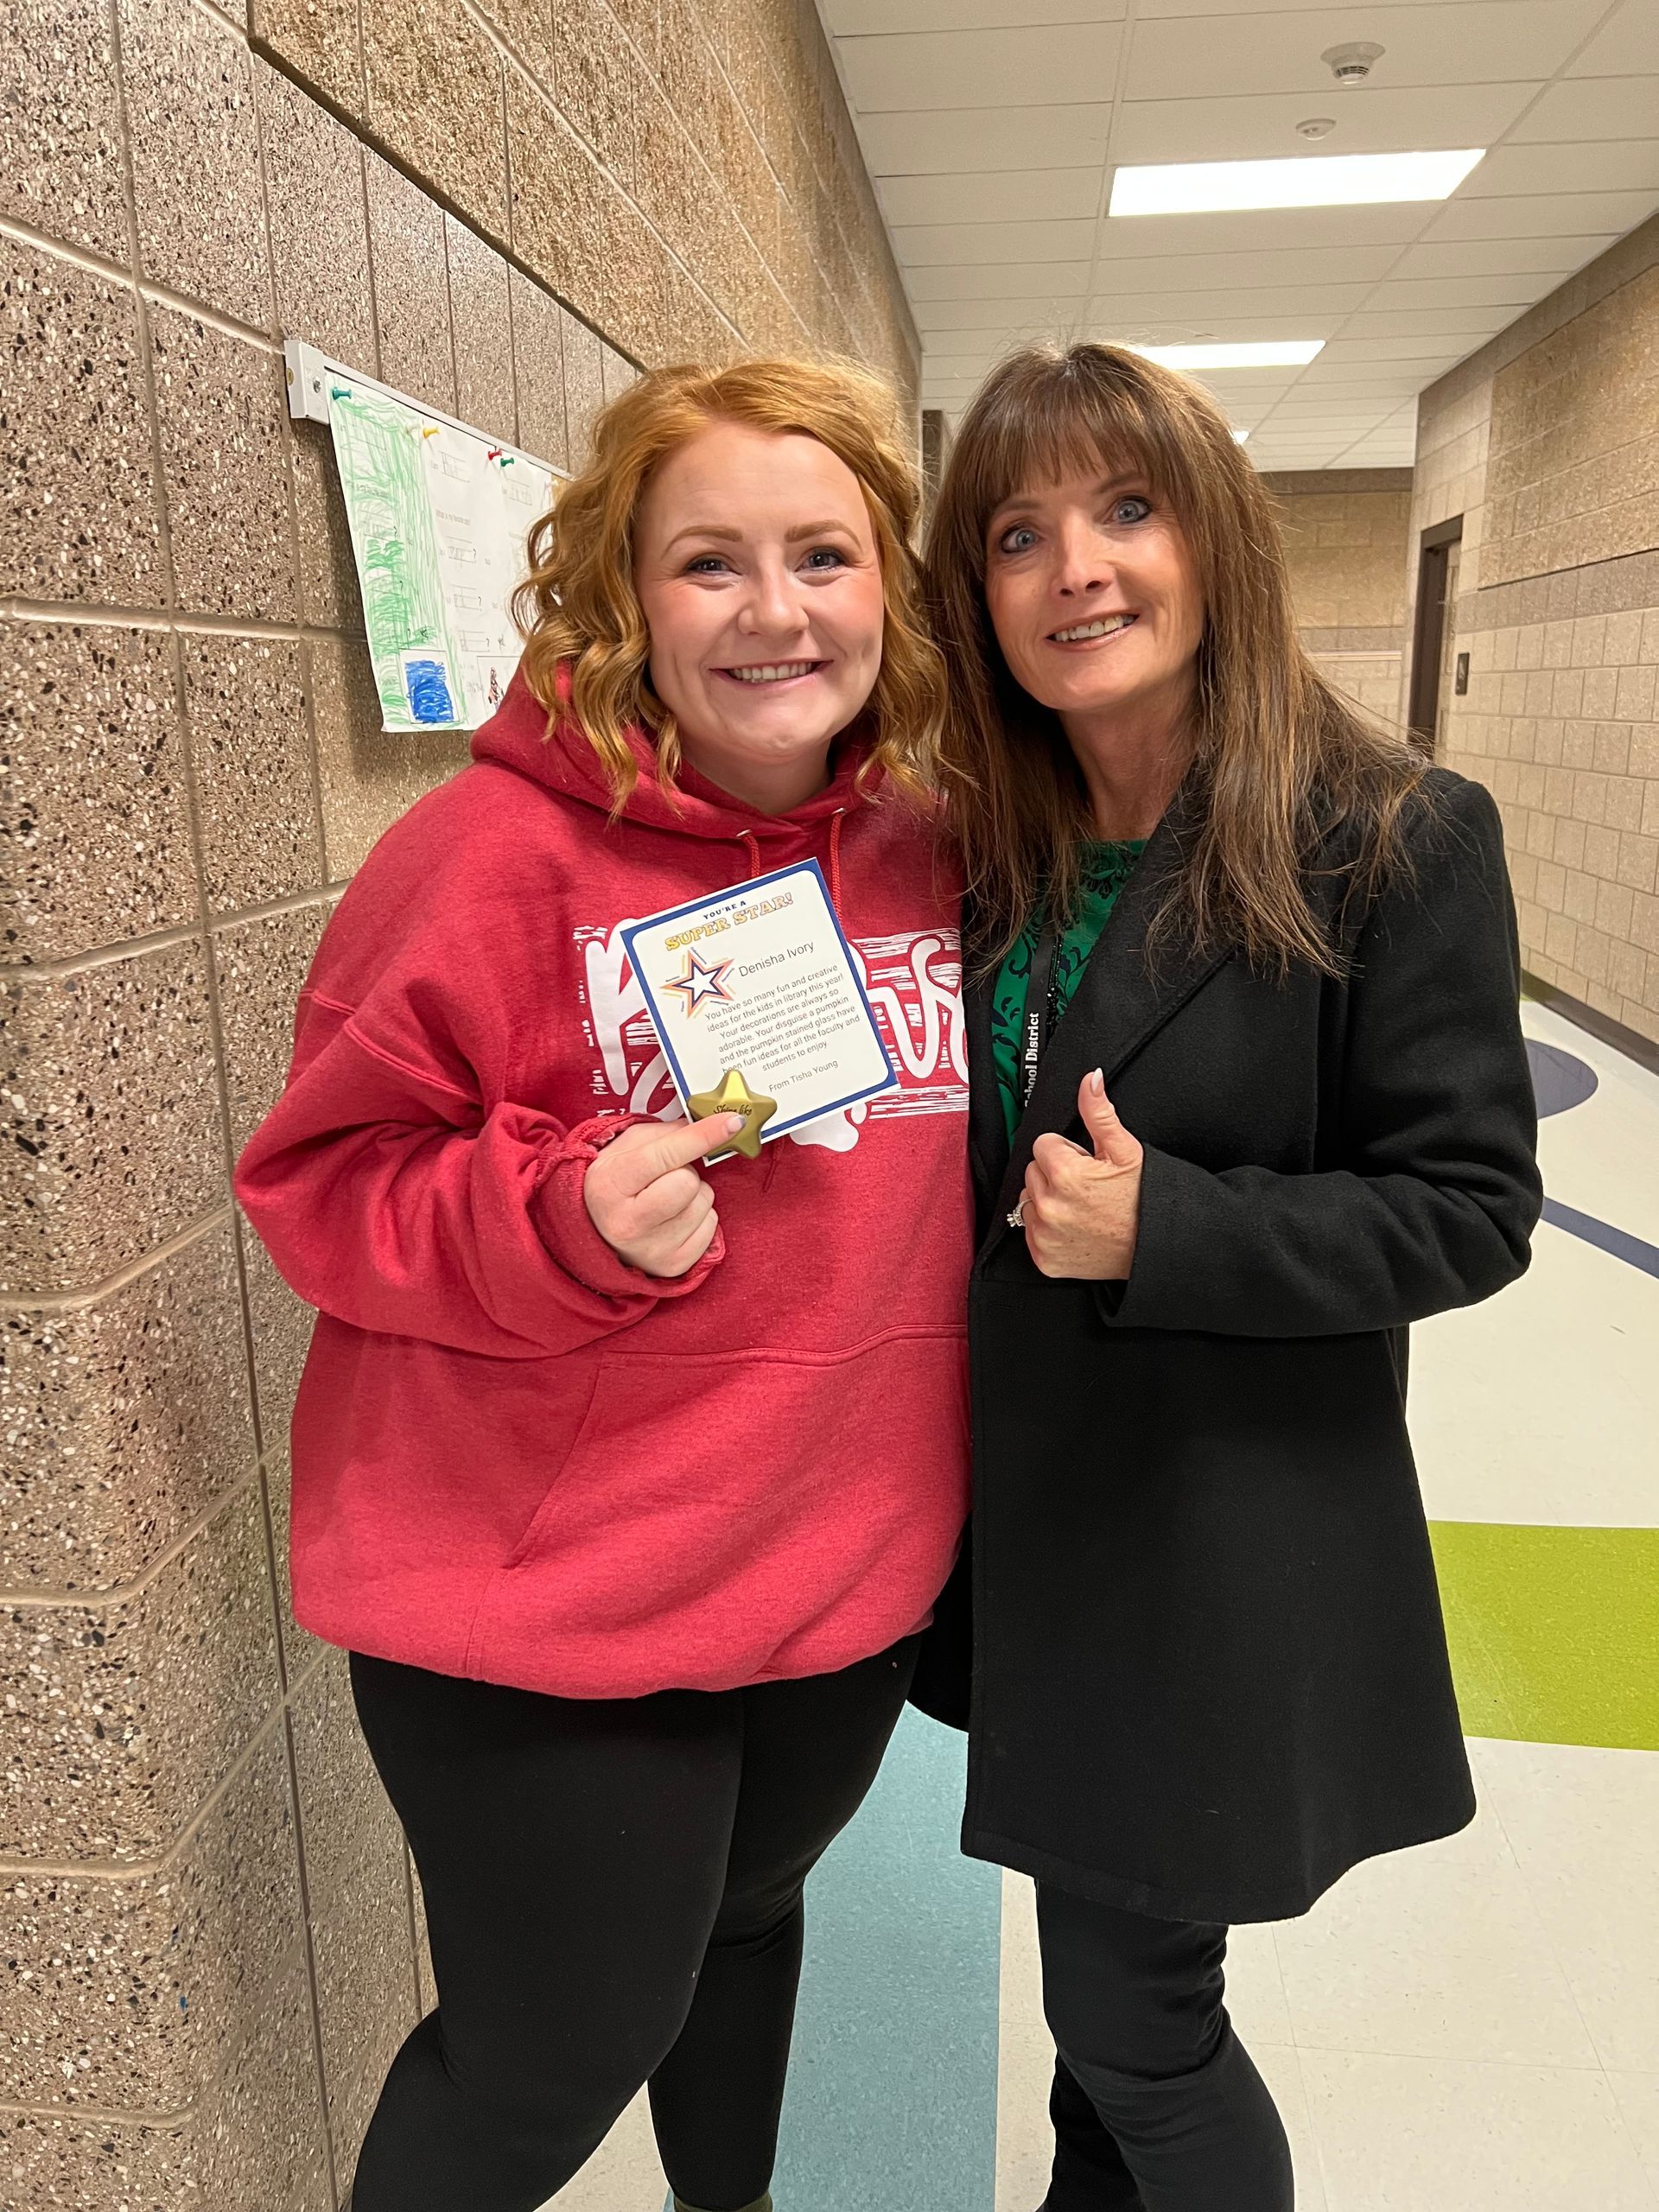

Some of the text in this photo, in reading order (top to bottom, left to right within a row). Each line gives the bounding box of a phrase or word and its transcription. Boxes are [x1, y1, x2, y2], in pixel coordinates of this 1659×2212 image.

[664, 893, 794, 951] SUPER STAR!
[702, 904, 738, 919] YOU'RE
[739, 942, 815, 977] Denisha Ivory
[705, 1010, 721, 1020] You
[721, 1003, 741, 1014] have
[753, 989, 775, 1002] many
[776, 983, 790, 993] fun
[791, 976, 806, 988] and
[807, 964, 838, 982] creative
[707, 1020, 729, 1033] ideas
[729, 1014, 741, 1024] for
[743, 1009, 756, 1019] the
[756, 1001, 774, 1013] kids
[783, 989, 808, 1003] library
[809, 982, 823, 993] this
[824, 973, 844, 988] year!
[719, 988, 839, 1039] Your decorations are always so
[718, 1033, 754, 1052] adorable.
[755, 1025, 774, 1038] Your
[775, 1013, 808, 1030] disguise
[815, 996, 849, 1015] pumpkin
[720, 1006, 855, 1065] and the pumpkin stained glass have
[743, 1056, 757, 1067] fun
[757, 1048, 779, 1061] ideas
[779, 1043, 791, 1052] for
[793, 1036, 804, 1047] all
[804, 1033, 817, 1043] the
[817, 1022, 843, 1037] faculty
[845, 1014, 860, 1027] and
[762, 1040, 828, 1071] students to enjoy
[768, 1060, 839, 1092] From Tisha Young
[1024, 1013, 1039, 1108] hool District
[739, 1104, 753, 1116] like
